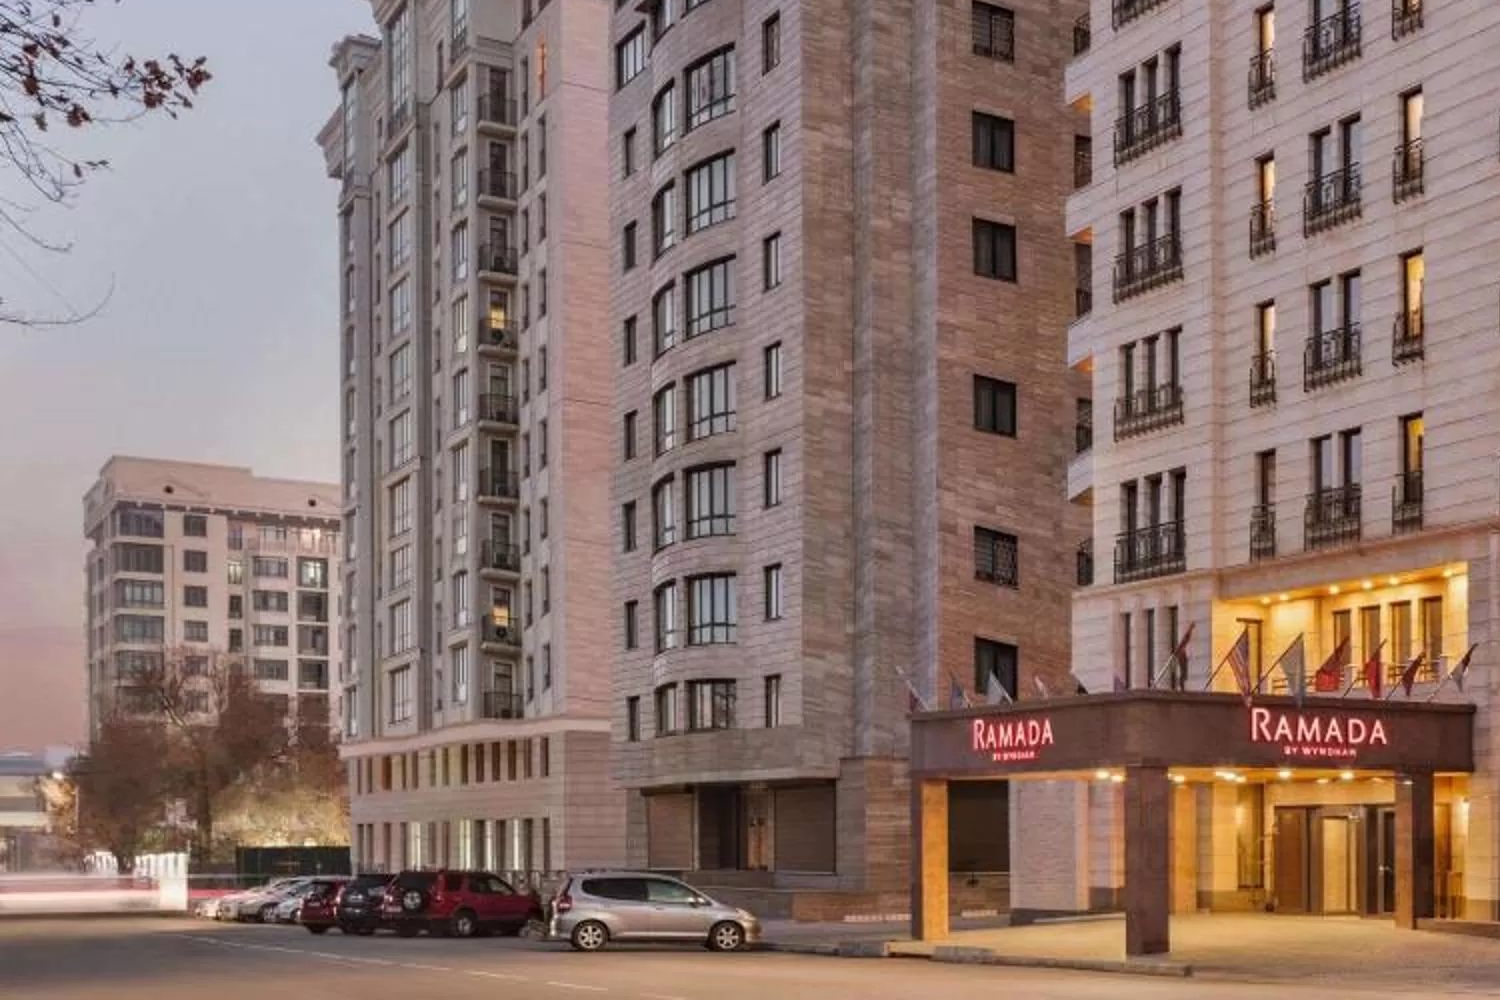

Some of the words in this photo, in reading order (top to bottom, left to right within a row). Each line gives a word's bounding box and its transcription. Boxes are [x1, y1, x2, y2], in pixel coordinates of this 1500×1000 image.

[973, 718, 1053, 751] RAMADA
[1251, 707, 1387, 745] RAMADA
[1284, 745, 1298, 756] BY
